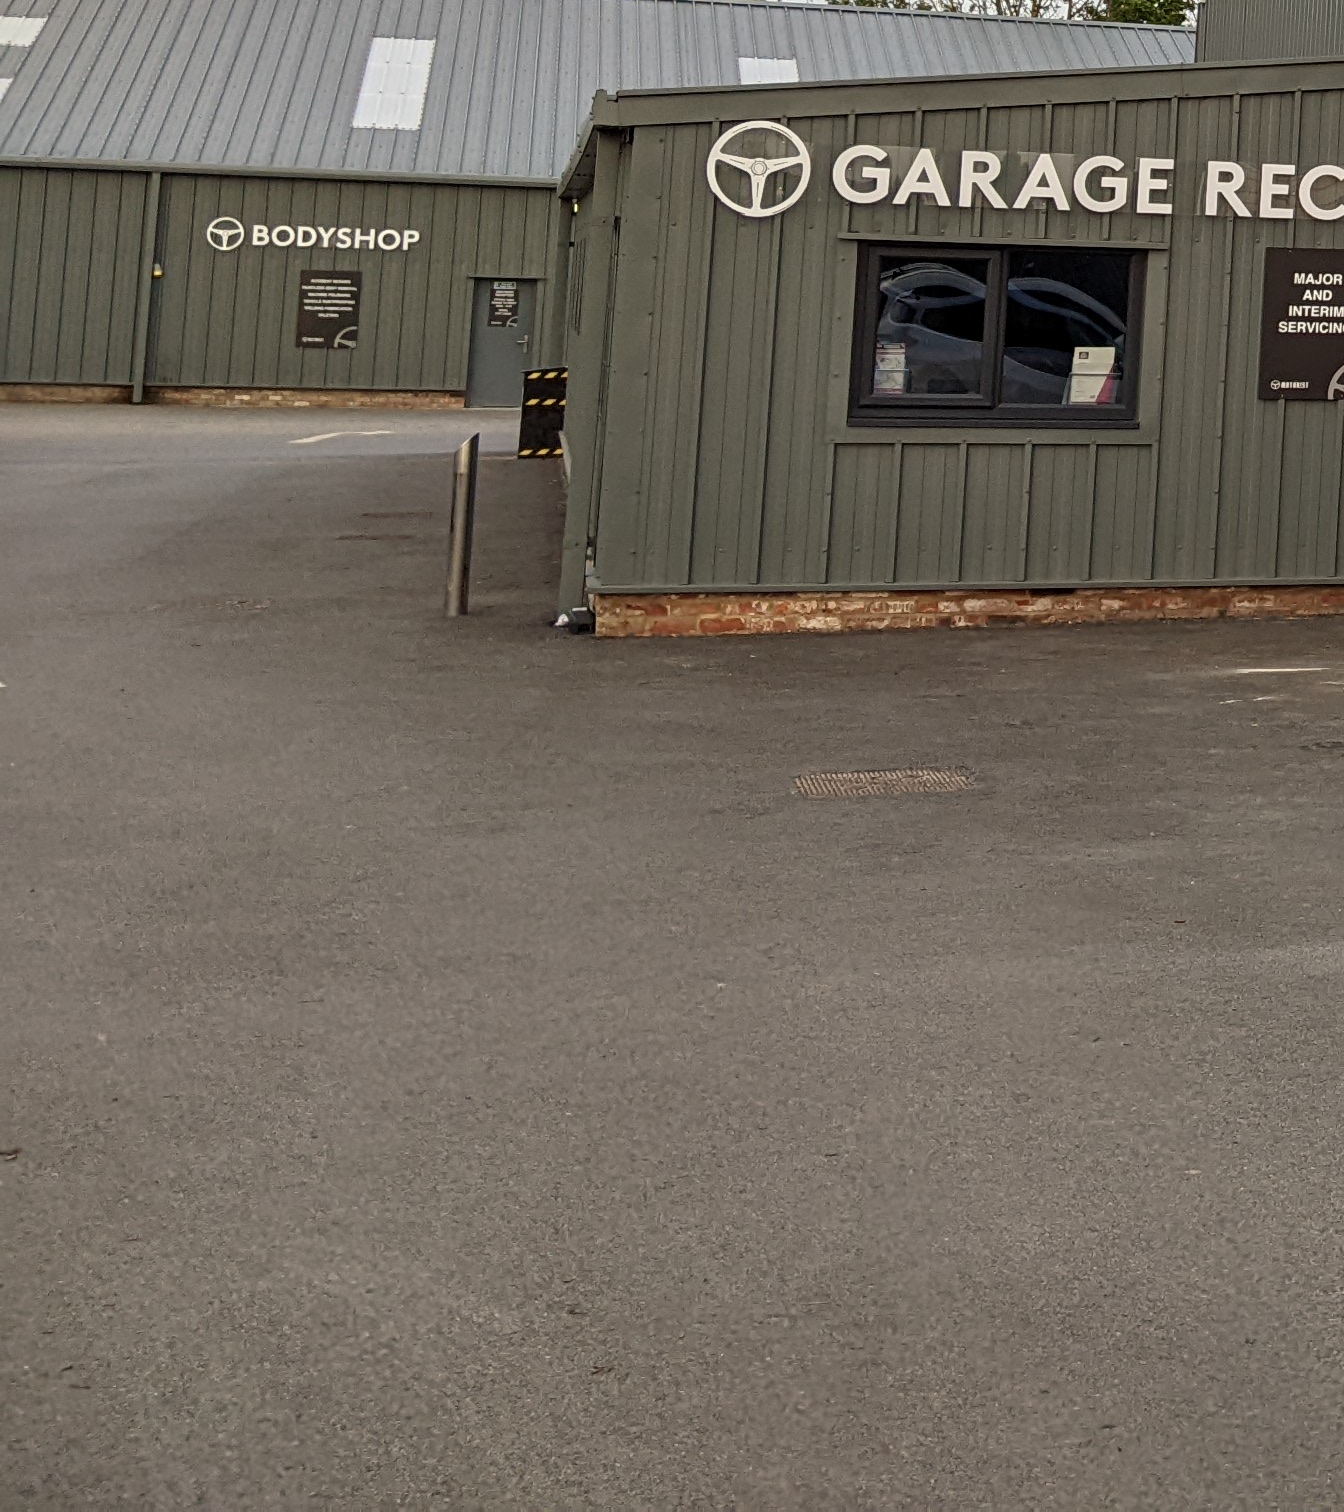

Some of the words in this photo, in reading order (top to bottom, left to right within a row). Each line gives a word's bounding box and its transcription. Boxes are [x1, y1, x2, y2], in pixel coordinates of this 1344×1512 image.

[832, 144, 1175, 215] GARAGE
[251, 224, 421, 252] BODYSHOP
[1293, 272, 1343, 286] MAJOR
[1302, 289, 1333, 301] AND
[1288, 305, 1344, 318] INTERIM
